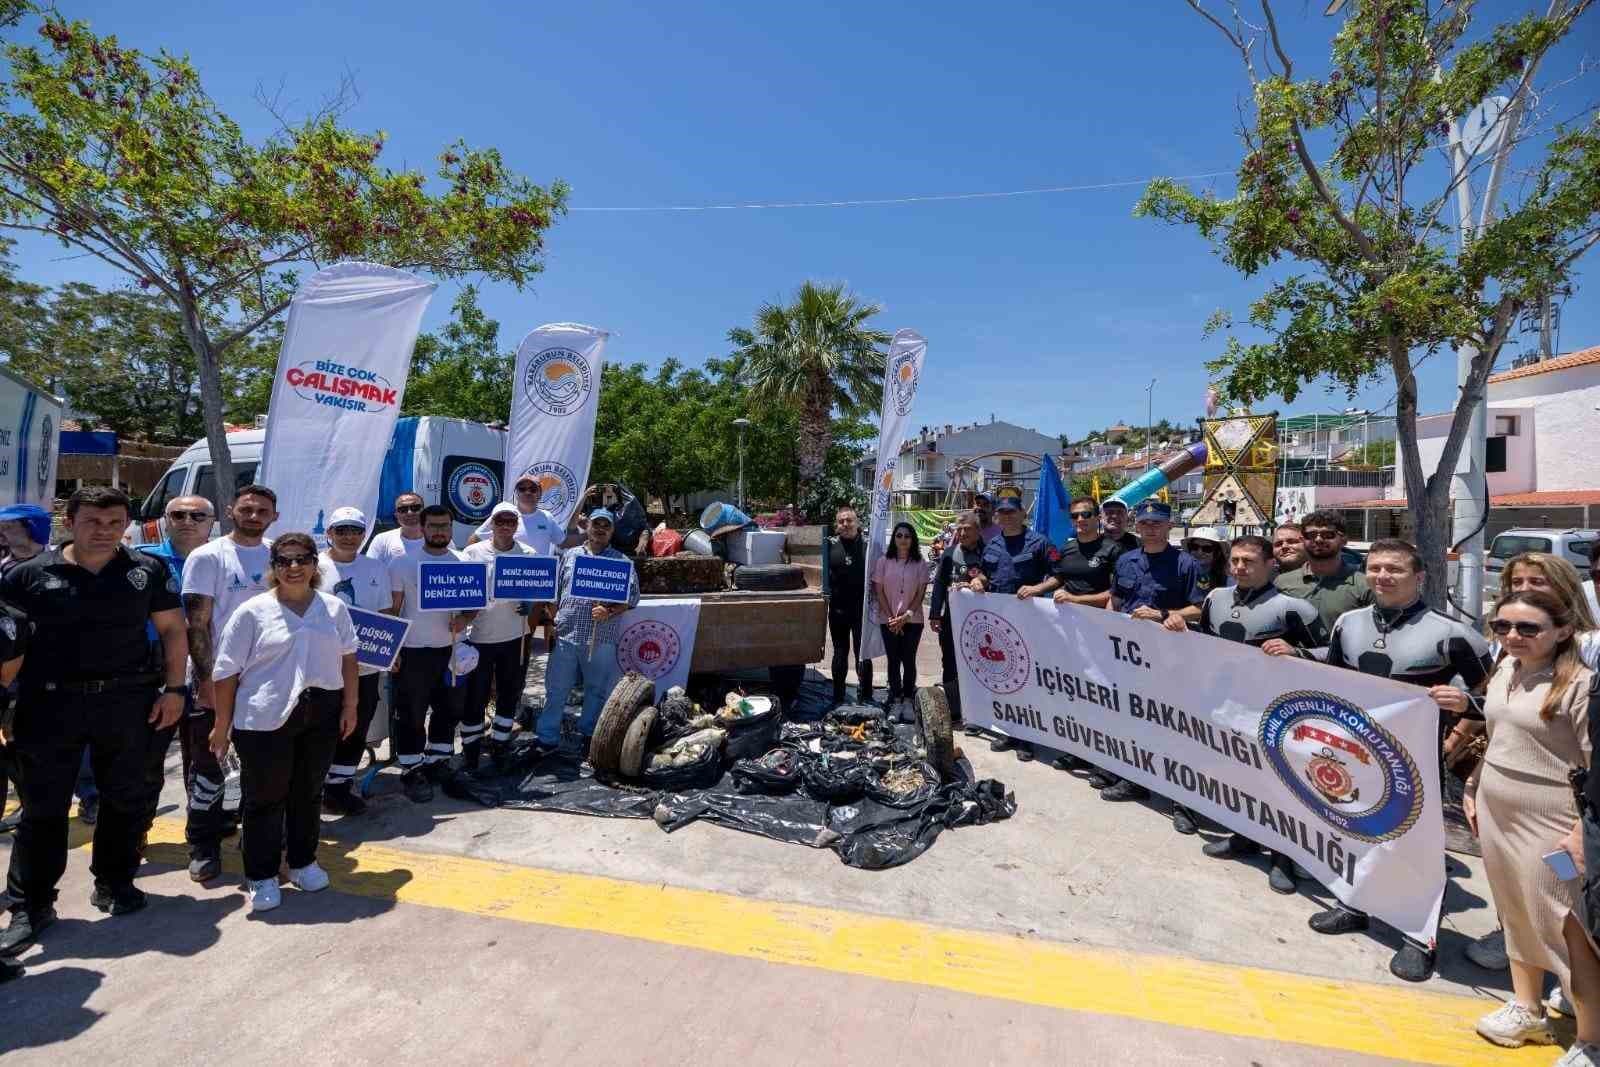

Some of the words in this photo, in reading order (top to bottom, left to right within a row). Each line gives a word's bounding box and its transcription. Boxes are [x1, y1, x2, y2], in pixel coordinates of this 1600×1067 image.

[315, 359, 345, 376] BİZE
[502, 567, 522, 576] DENİZ
[576, 567, 627, 580] DENİZLERDEN
[424, 587, 458, 599] DENİZE
[459, 588, 483, 598] ATMA
[575, 579, 626, 592] SORUMLUYUZ
[380, 646, 392, 656] OL
[1108, 635, 1151, 669] T.C.
[1034, 661, 1120, 713] İÇİŞLERİ
[1129, 692, 1263, 770] BAKANLIĞI
[1266, 719, 1283, 747] SAHİL
[1279, 700, 1336, 719] GÜVENLİK
[1339, 709, 1411, 795] KOMUTANLIĞI
[992, 700, 1048, 733] SAHİL
[1052, 715, 1157, 776] GÜVENLİK
[1163, 757, 1356, 886] KOMUTANLIĞI
